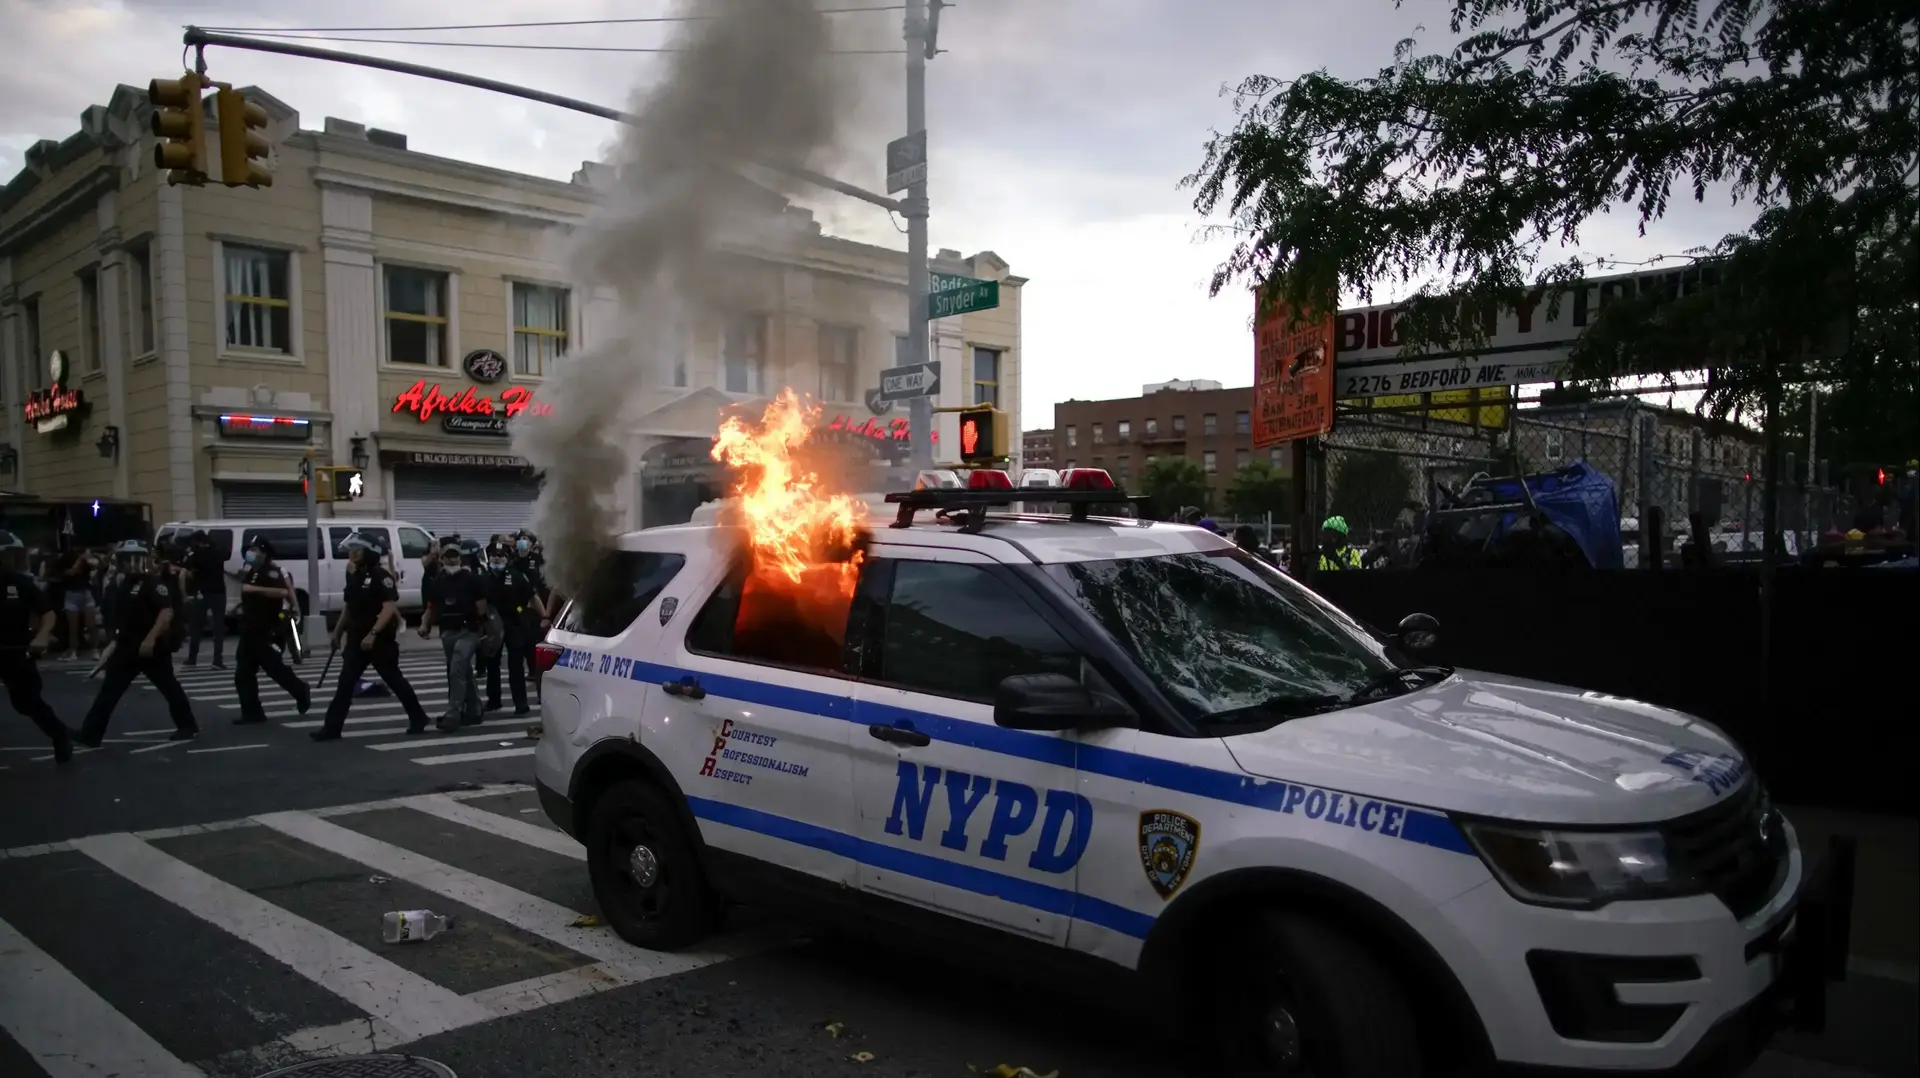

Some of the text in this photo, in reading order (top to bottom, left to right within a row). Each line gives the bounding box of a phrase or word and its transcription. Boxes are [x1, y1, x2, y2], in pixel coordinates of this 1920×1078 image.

[936, 290, 975, 315] Snyder
[886, 373, 924, 391] ONE WAY
[1346, 375, 1391, 394] 2276
[1400, 367, 1471, 389] BEDFORD
[1476, 363, 1505, 383] AVE.
[391, 379, 495, 423] Afrika
[1262, 399, 1285, 418] 8AM
[449, 416, 505, 430] Banquet &
[1303, 406, 1325, 428] ROUTE
[415, 452, 422, 463] EL
[423, 453, 448, 464] PALACIO
[449, 454, 476, 465] ELEGANTE
[477, 455, 484, 465] DE
[599, 654, 611, 675] 70
[612, 656, 632, 678] PCT
[721, 719, 778, 747] COURTESY
[711, 736, 809, 777] PROFESSIONALISM
[699, 757, 753, 786] RESPECT
[884, 760, 1093, 874] NYPD
[1154, 813, 1188, 829] POLICE
[1282, 784, 1404, 838] POLICE
[1142, 822, 1195, 844] DEPARTMENT
[1141, 845, 1158, 881] CITY OF
[1168, 850, 1193, 890] NEW YORK
